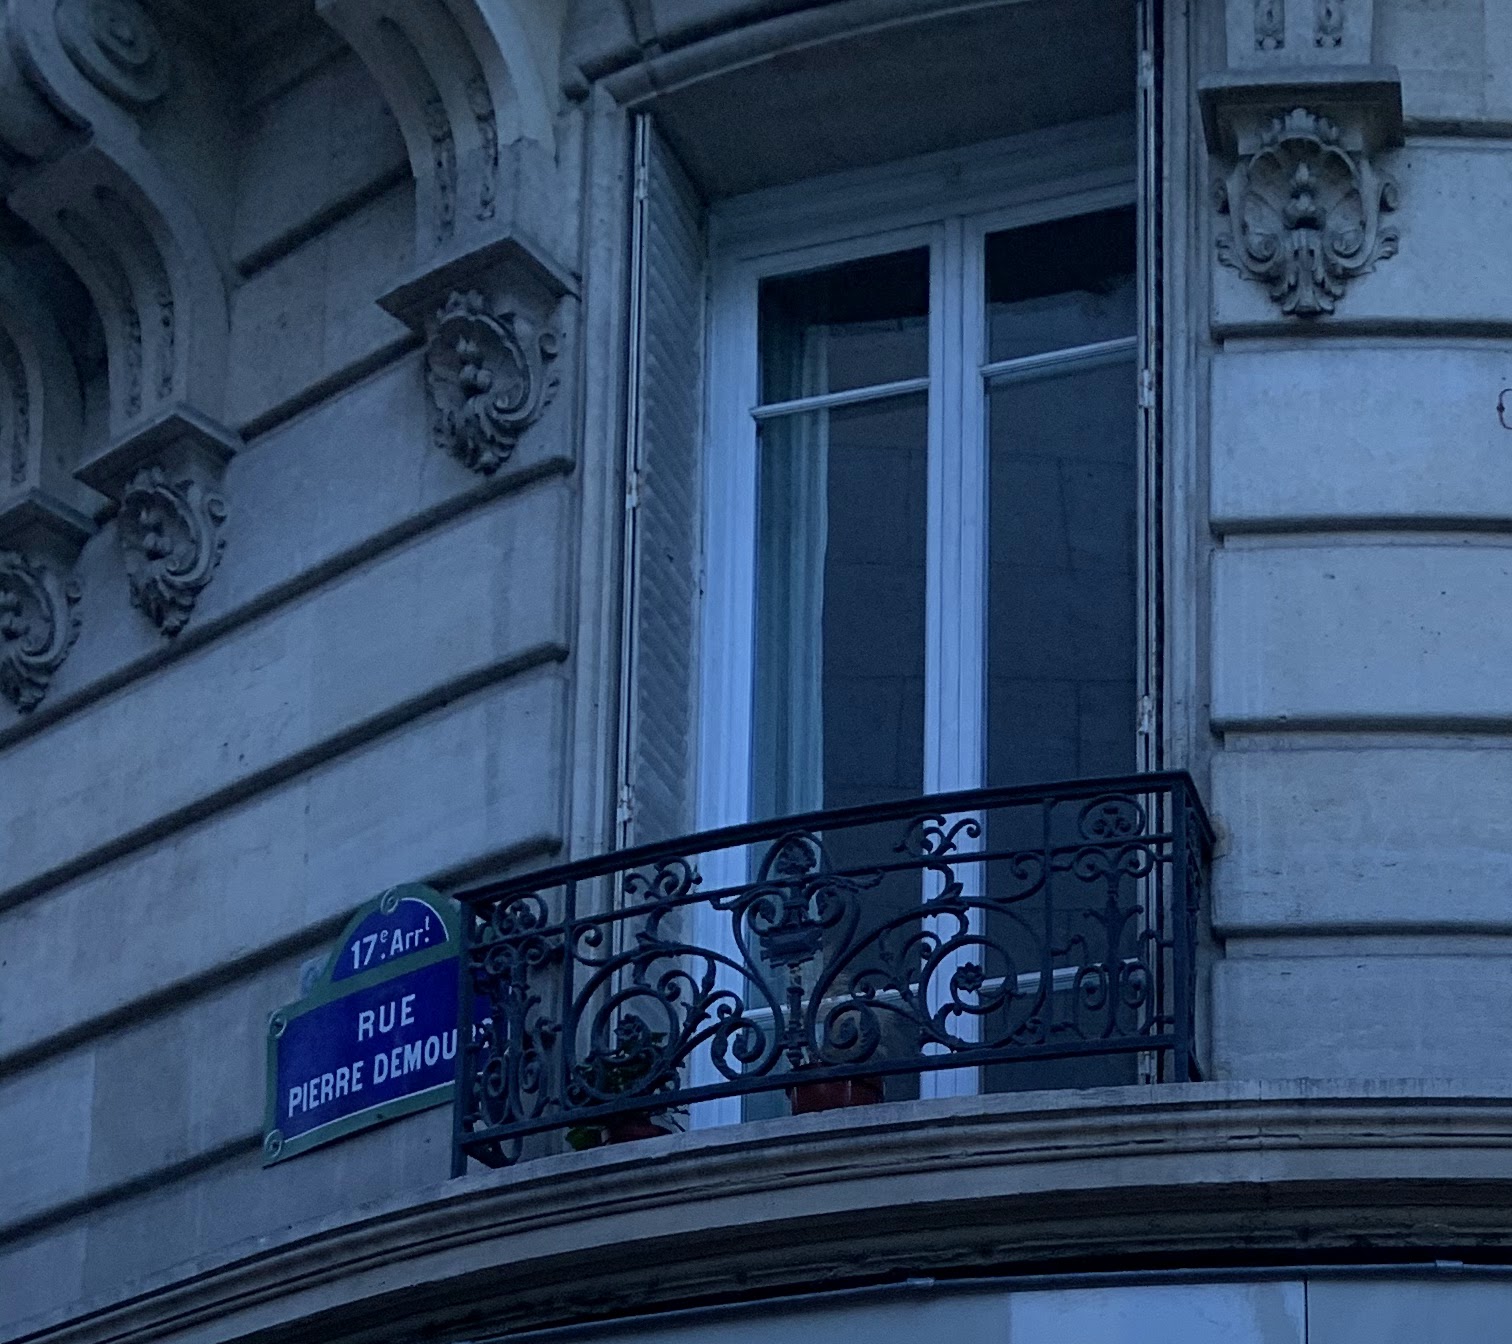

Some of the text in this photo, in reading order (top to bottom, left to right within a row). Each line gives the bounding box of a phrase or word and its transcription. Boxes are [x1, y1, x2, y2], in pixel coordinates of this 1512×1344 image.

[357, 993, 417, 1042] RUE
[288, 1018, 494, 1119] PIERRE DEMOU
